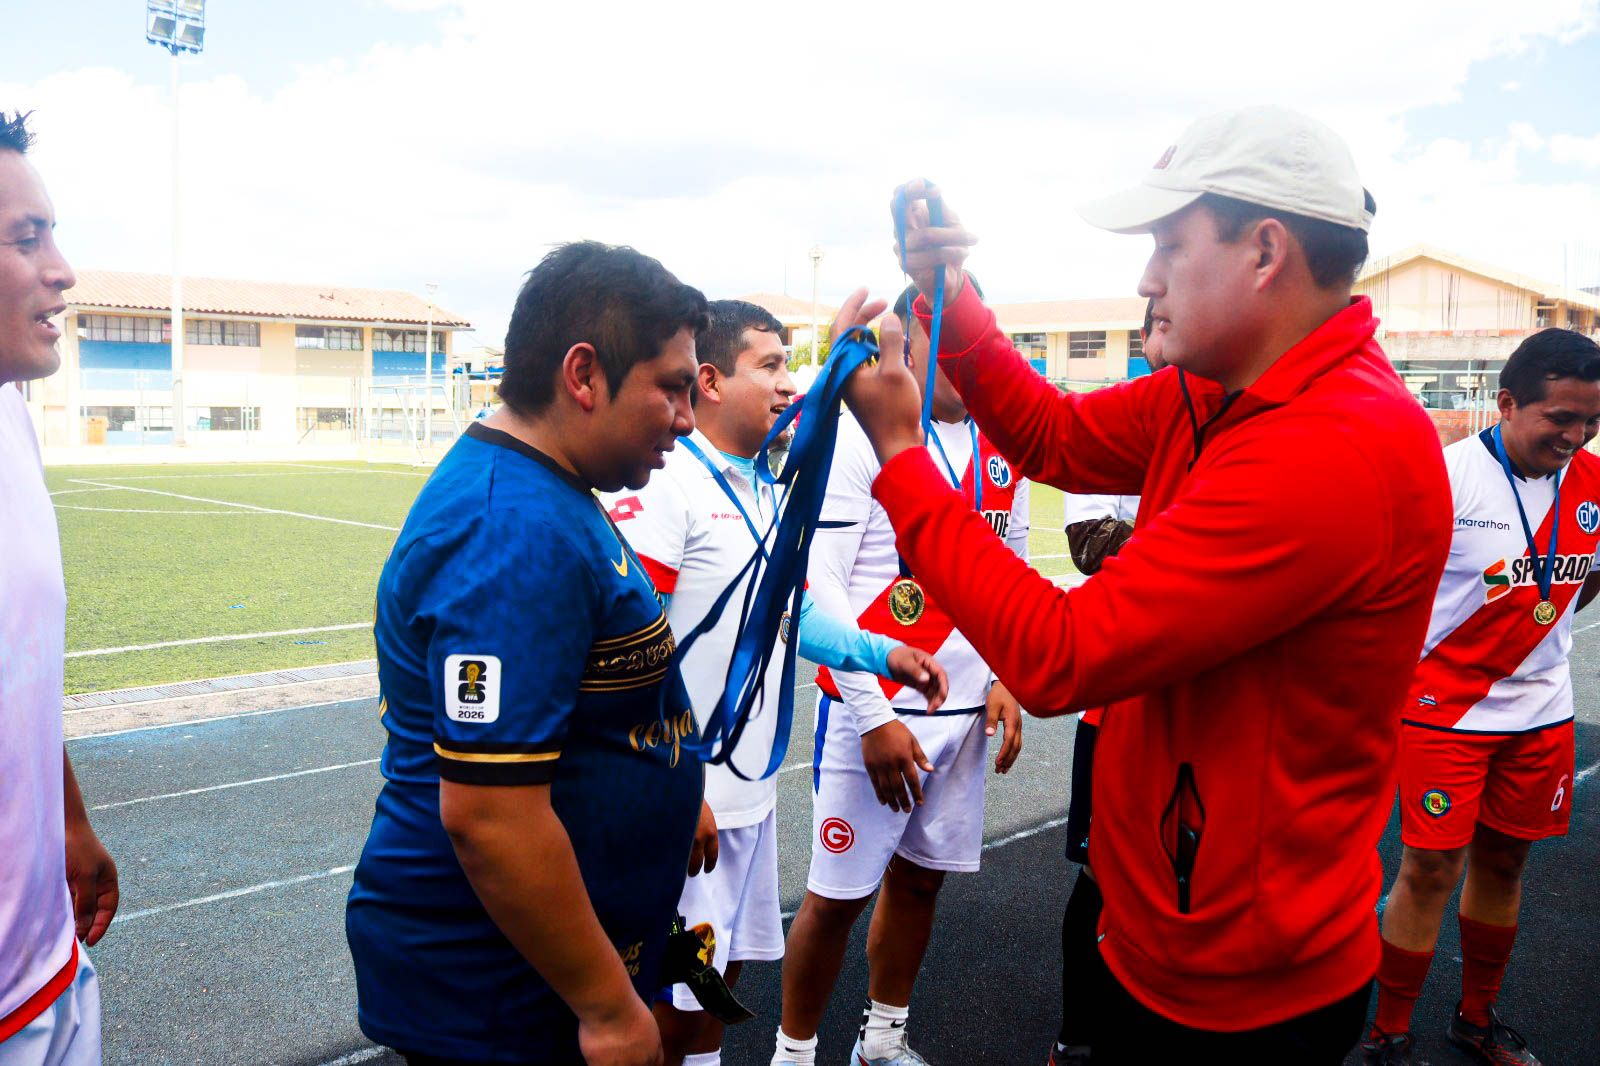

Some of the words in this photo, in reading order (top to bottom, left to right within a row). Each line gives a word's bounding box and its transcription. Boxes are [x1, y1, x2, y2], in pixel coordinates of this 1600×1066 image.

[1512, 555, 1594, 584] SPRAD
[458, 710, 485, 719] 2026
[823, 821, 850, 850] G
